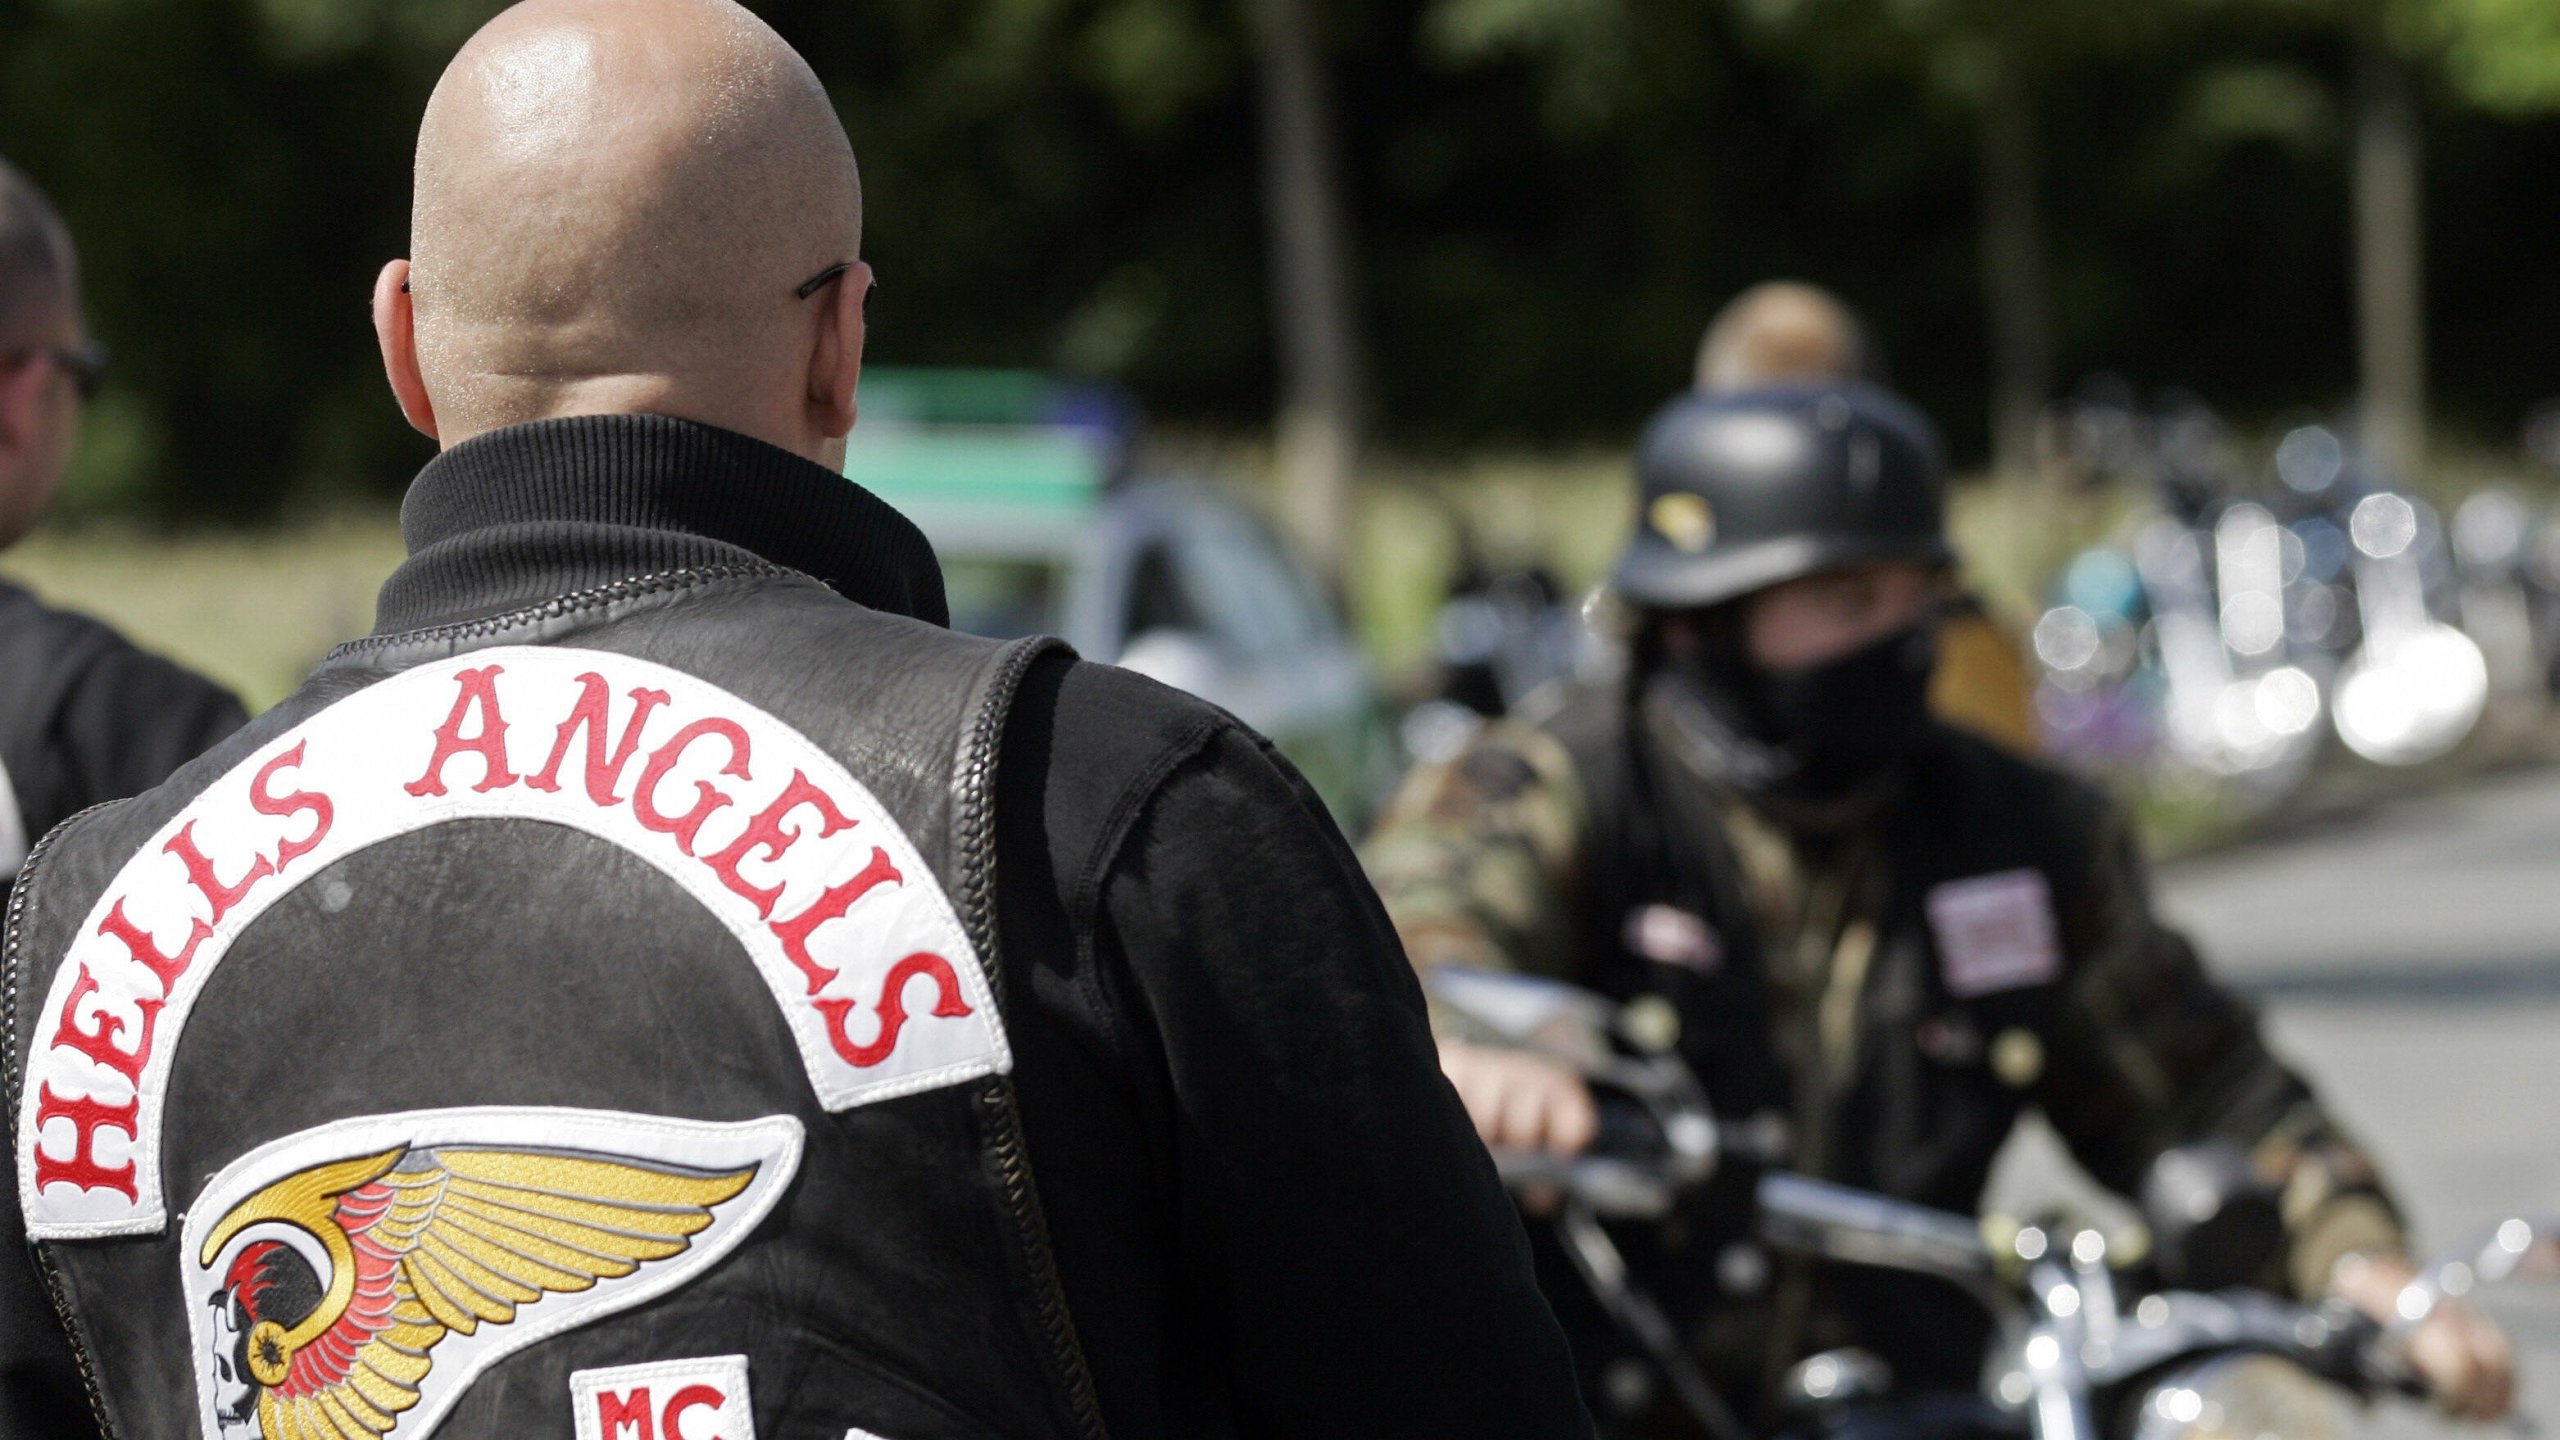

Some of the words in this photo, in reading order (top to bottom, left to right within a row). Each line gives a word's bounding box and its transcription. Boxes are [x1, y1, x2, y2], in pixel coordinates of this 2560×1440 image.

[34, 739, 334, 1205] HELLS
[404, 665, 974, 1068] ANGELS
[597, 1384, 726, 1440] MC
